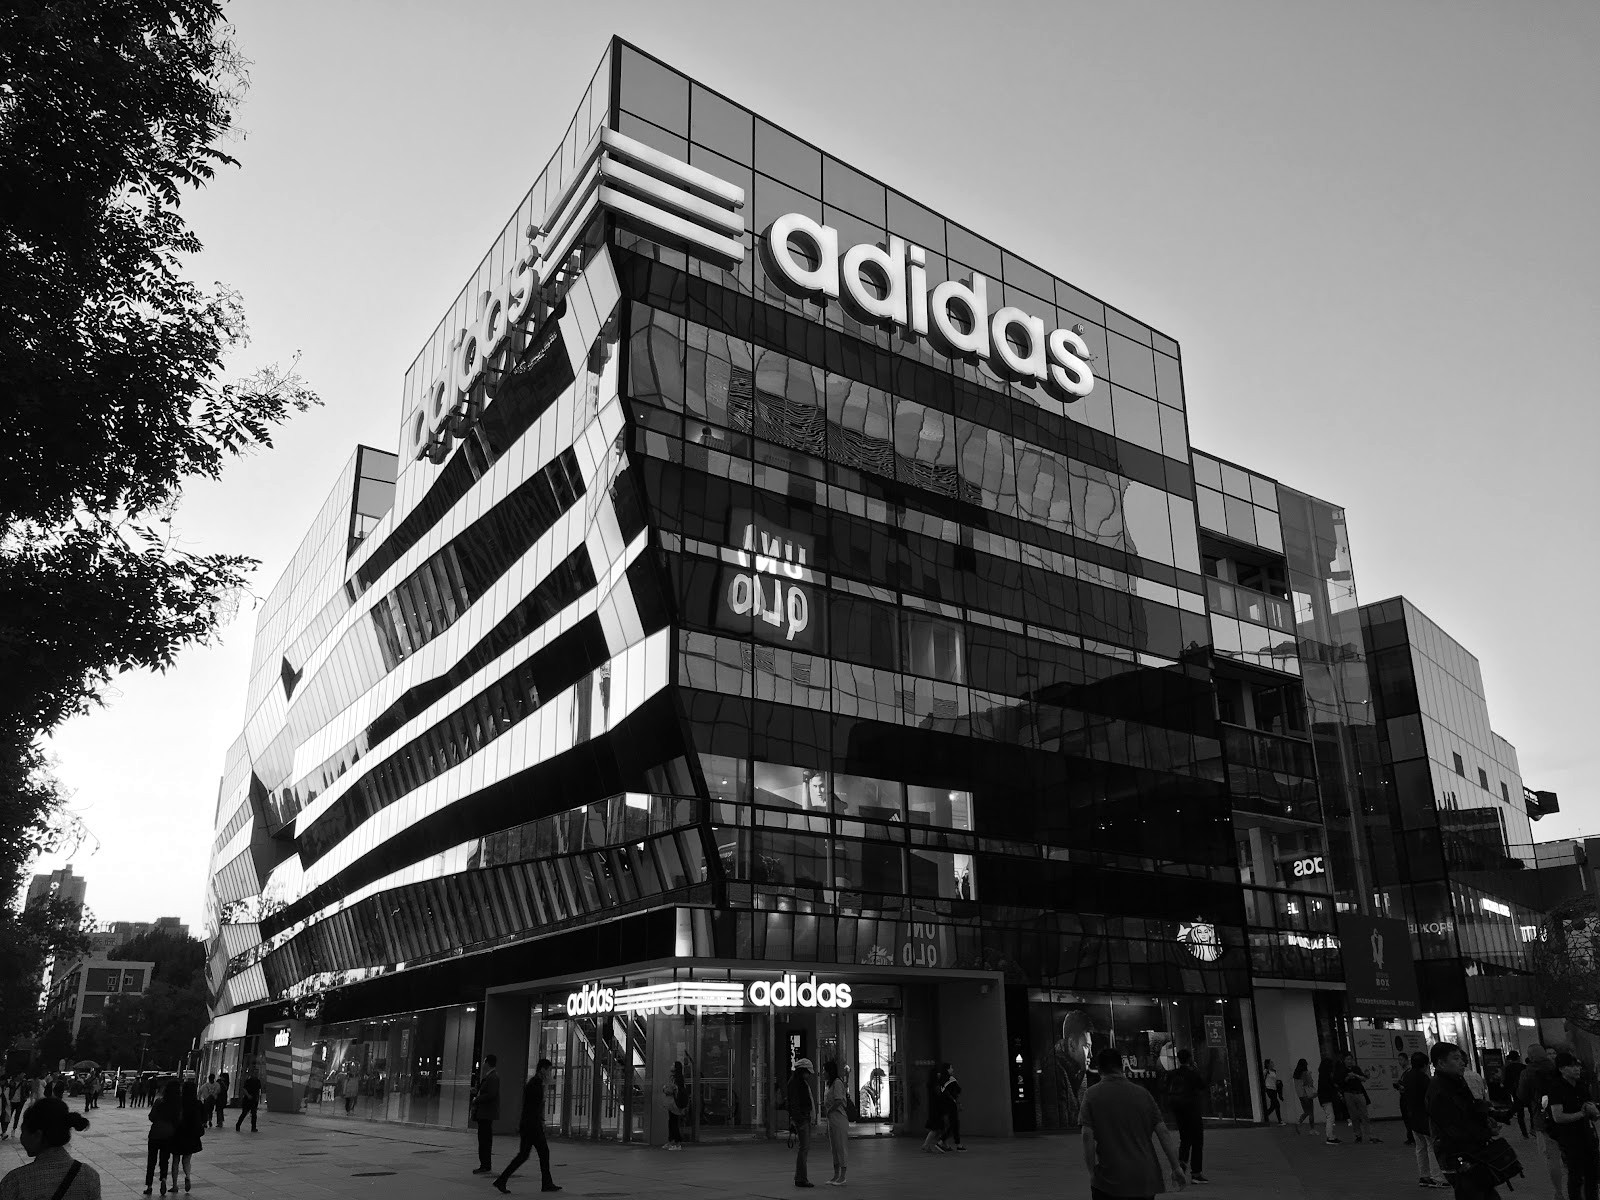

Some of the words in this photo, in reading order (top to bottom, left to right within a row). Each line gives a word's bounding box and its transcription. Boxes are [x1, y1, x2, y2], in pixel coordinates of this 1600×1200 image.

[411, 244, 538, 461] adidas
[766, 212, 1095, 401] adidas
[566, 981, 615, 1017] adidas
[748, 974, 852, 1008] adidas
